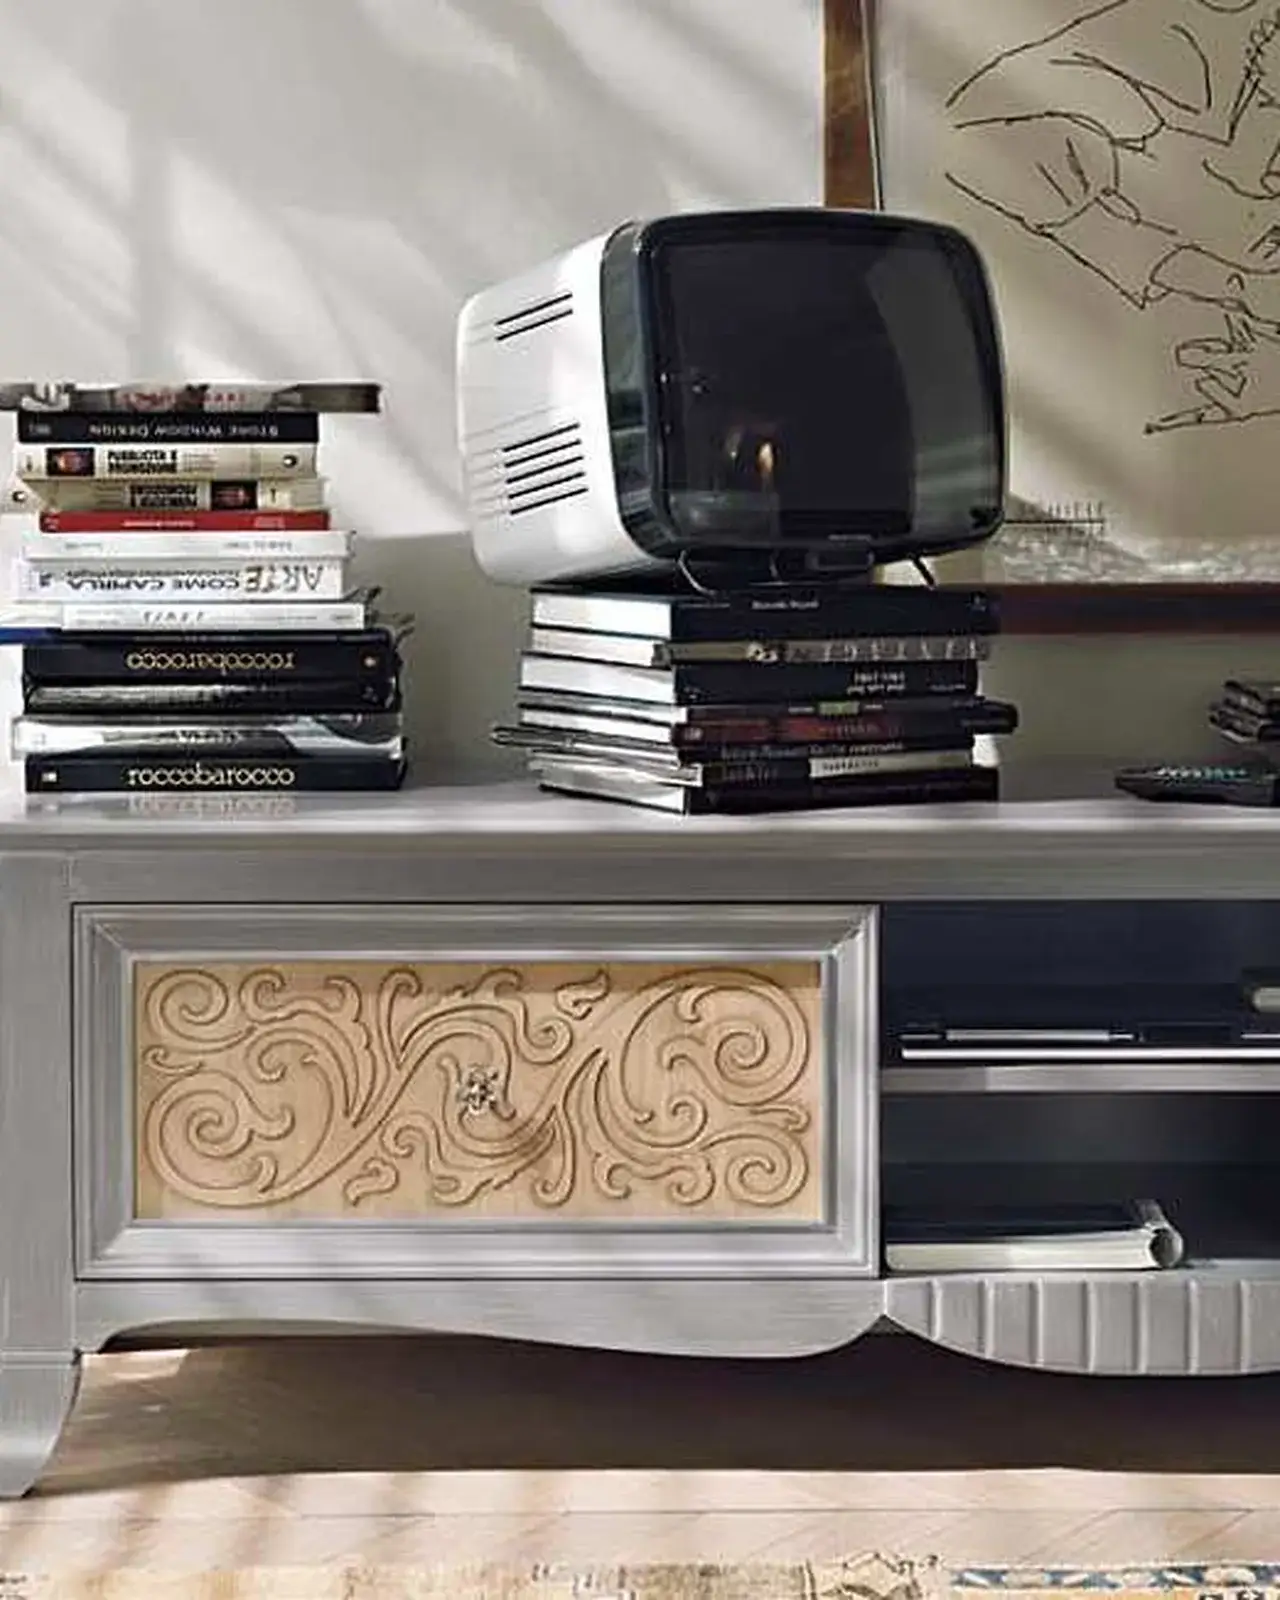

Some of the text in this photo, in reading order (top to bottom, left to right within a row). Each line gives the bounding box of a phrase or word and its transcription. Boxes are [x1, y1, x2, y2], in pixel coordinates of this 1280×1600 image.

[172, 579, 240, 591] COME
[245, 565, 324, 593] ARTE
[126, 647, 296, 675] roccobarocco
[126, 762, 296, 787] roccobarocco
